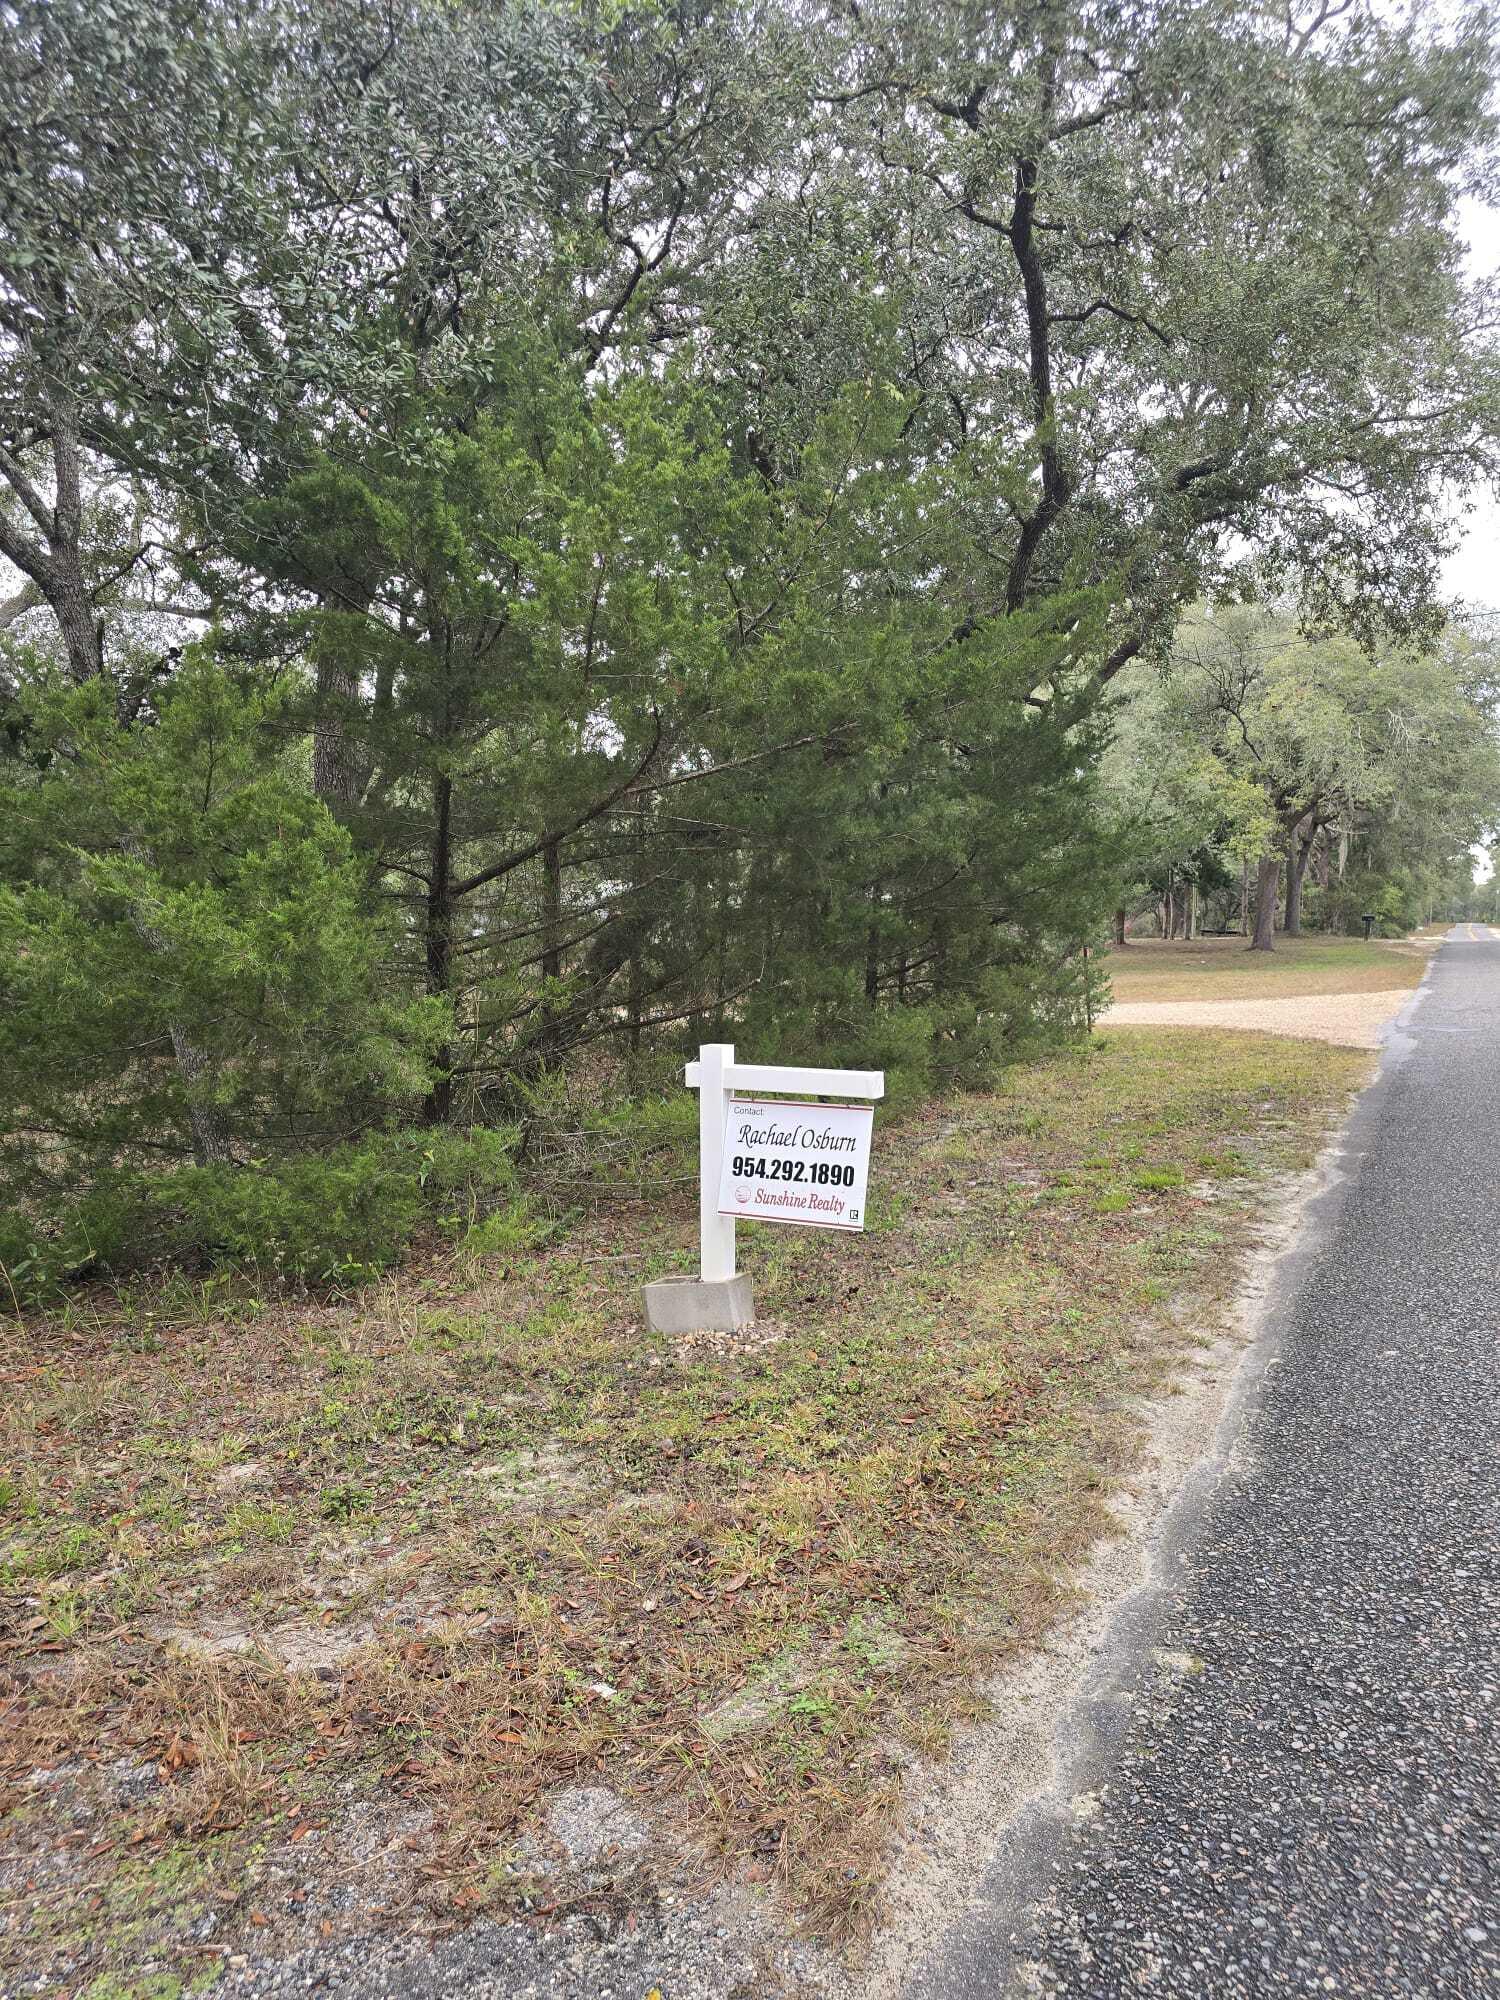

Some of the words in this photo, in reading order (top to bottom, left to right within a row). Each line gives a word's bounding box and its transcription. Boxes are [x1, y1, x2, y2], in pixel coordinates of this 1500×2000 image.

[738, 1123, 802, 1149] Rachael
[801, 1128, 857, 1152] Osburn
[732, 1156, 855, 1187] 954.292.1890
[754, 1188, 807, 1208] Sunshine
[809, 1193, 845, 1215] Realty
